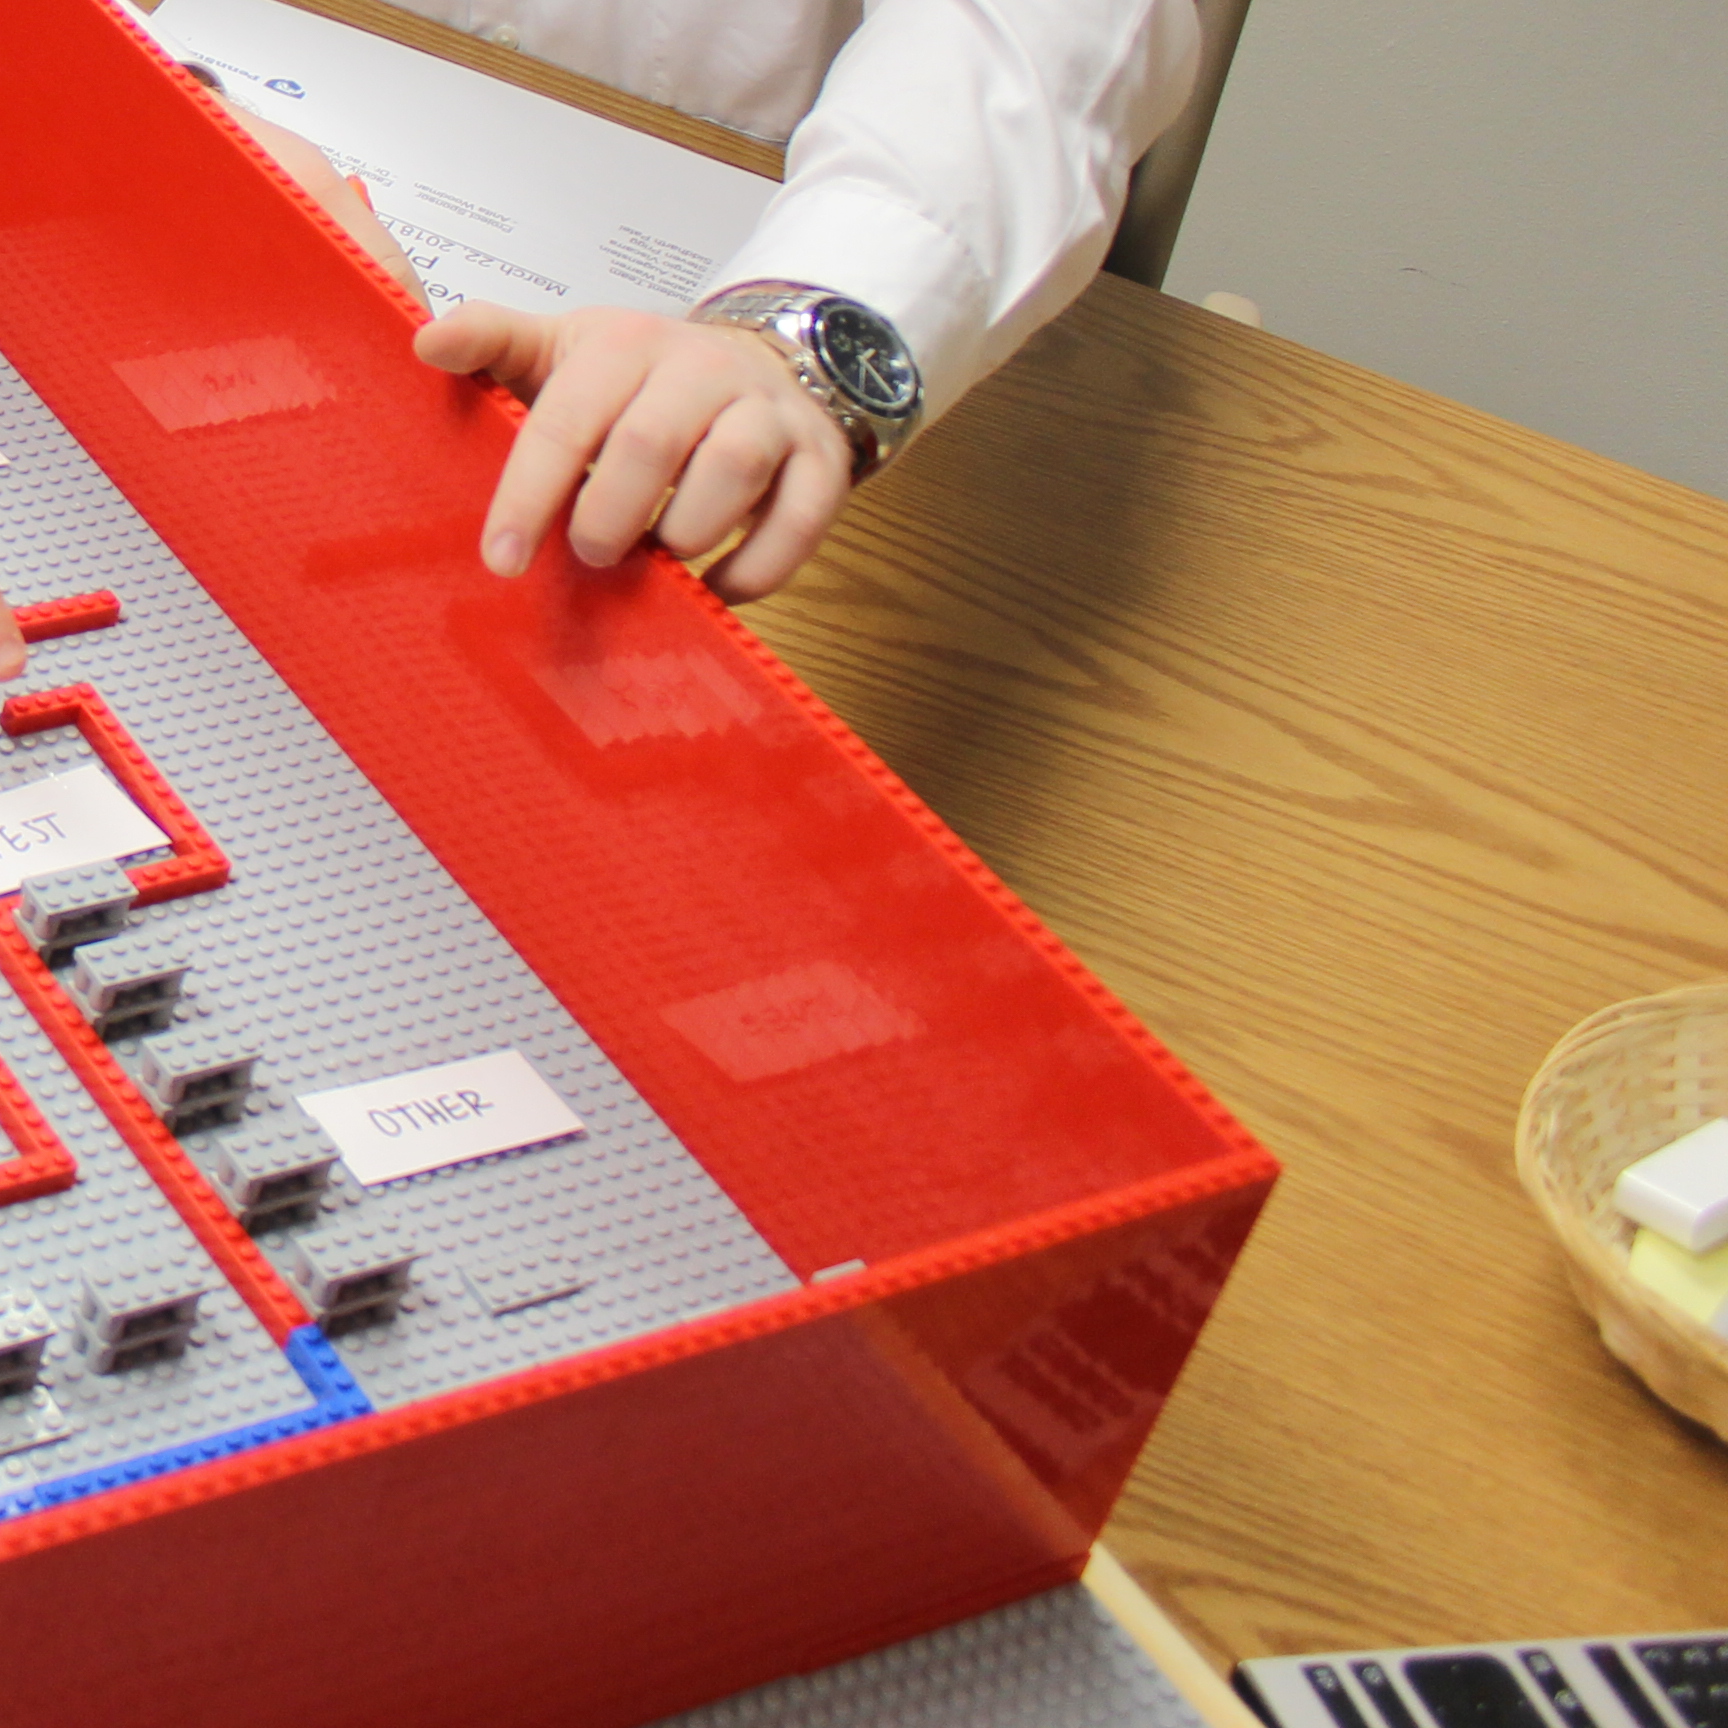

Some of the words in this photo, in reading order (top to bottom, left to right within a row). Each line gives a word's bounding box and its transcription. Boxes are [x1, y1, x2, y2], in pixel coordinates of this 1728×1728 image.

[189, 51, 260, 81] PennSt
[400, 224, 455, 253] 2018
[500, 262, 569, 296] March
[368, 1088, 494, 1137] OTHER
